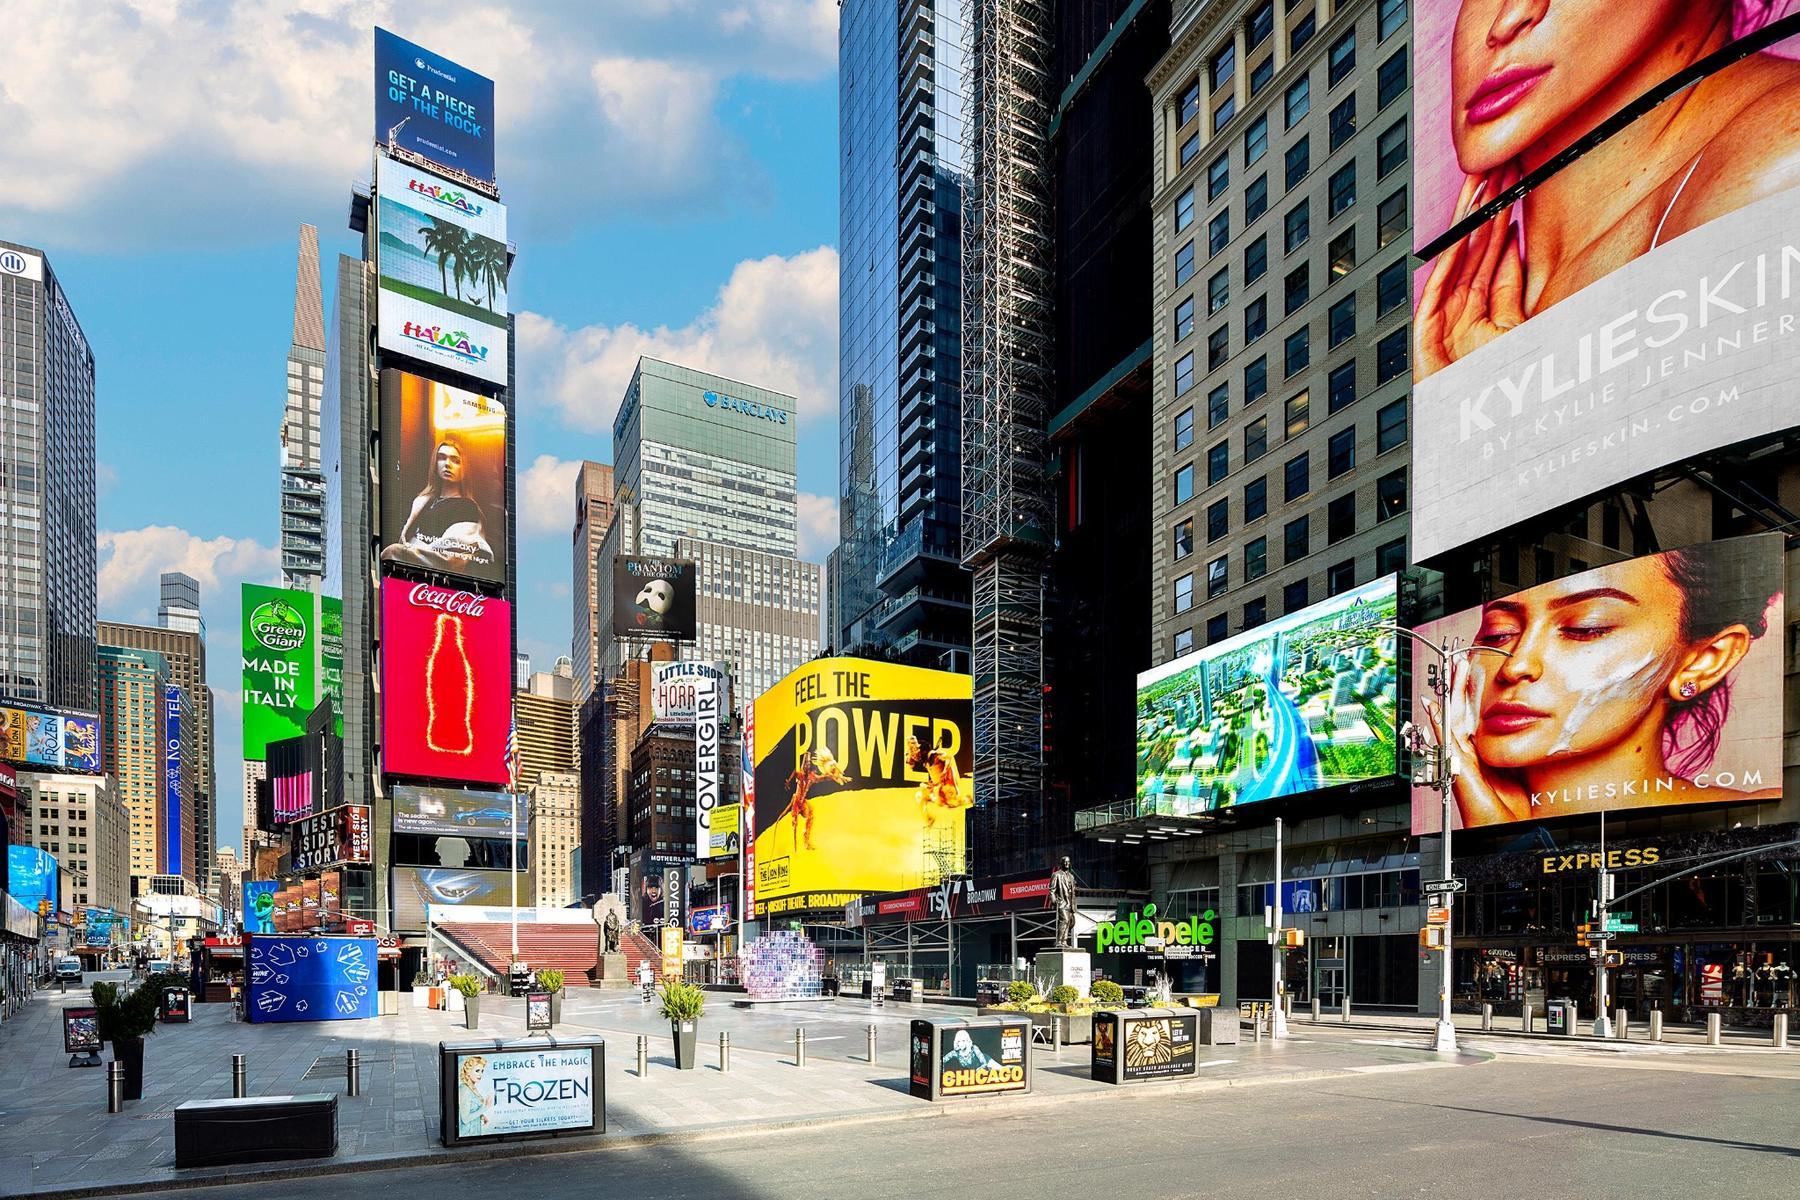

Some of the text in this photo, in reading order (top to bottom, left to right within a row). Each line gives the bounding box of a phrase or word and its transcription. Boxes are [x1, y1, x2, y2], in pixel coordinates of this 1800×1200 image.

[426, 64, 457, 83] Prudential
[388, 70, 476, 121] GET A PIECE
[388, 86, 482, 138] OF THE ROCK
[416, 136, 457, 158] prudential.com
[1482, 313, 1795, 461] BY KYLIE JENNER
[462, 399, 496, 414] SAMSUNG
[720, 395, 788, 425] BARCLAYS
[1518, 385, 1741, 487] KYLIESKIN.COM
[627, 562, 683, 575] PHANTOM
[656, 571, 678, 579] OPERA
[408, 582, 489, 618] Coca-Cola
[257, 622, 304, 638] Green
[262, 633, 304, 649] Giant
[241, 656, 301, 677] MADE
[659, 663, 724, 683] LITTLE SHOP
[274, 676, 296, 692] IN
[794, 671, 871, 708] FEEL THE
[243, 689, 299, 709] ITALY
[42, 716, 62, 763] FROZEN
[795, 707, 962, 790] POWER
[698, 681, 716, 830] COVERGIRL
[1530, 769, 1763, 807] KYLIESKIN.COM
[301, 811, 337, 836] WEST
[351, 806, 361, 860] WEST SIDE
[303, 829, 335, 852] SIDE
[299, 844, 340, 868] STORY
[650, 855, 695, 863] MOTHERLAND
[1543, 847, 1661, 874] EXPRESS
[927, 881, 953, 921] TSX
[966, 887, 997, 905] BROADWAY
[1096, 903, 1157, 954] pelé
[1108, 945, 1146, 954] SOCCER
[1544, 953, 1587, 961] EXPRESS
[493, 1054, 589, 1071] EMBRACE THE MAGIC
[942, 1065, 1024, 1088] CHICAGO
[492, 1075, 589, 1108] FROZEN
